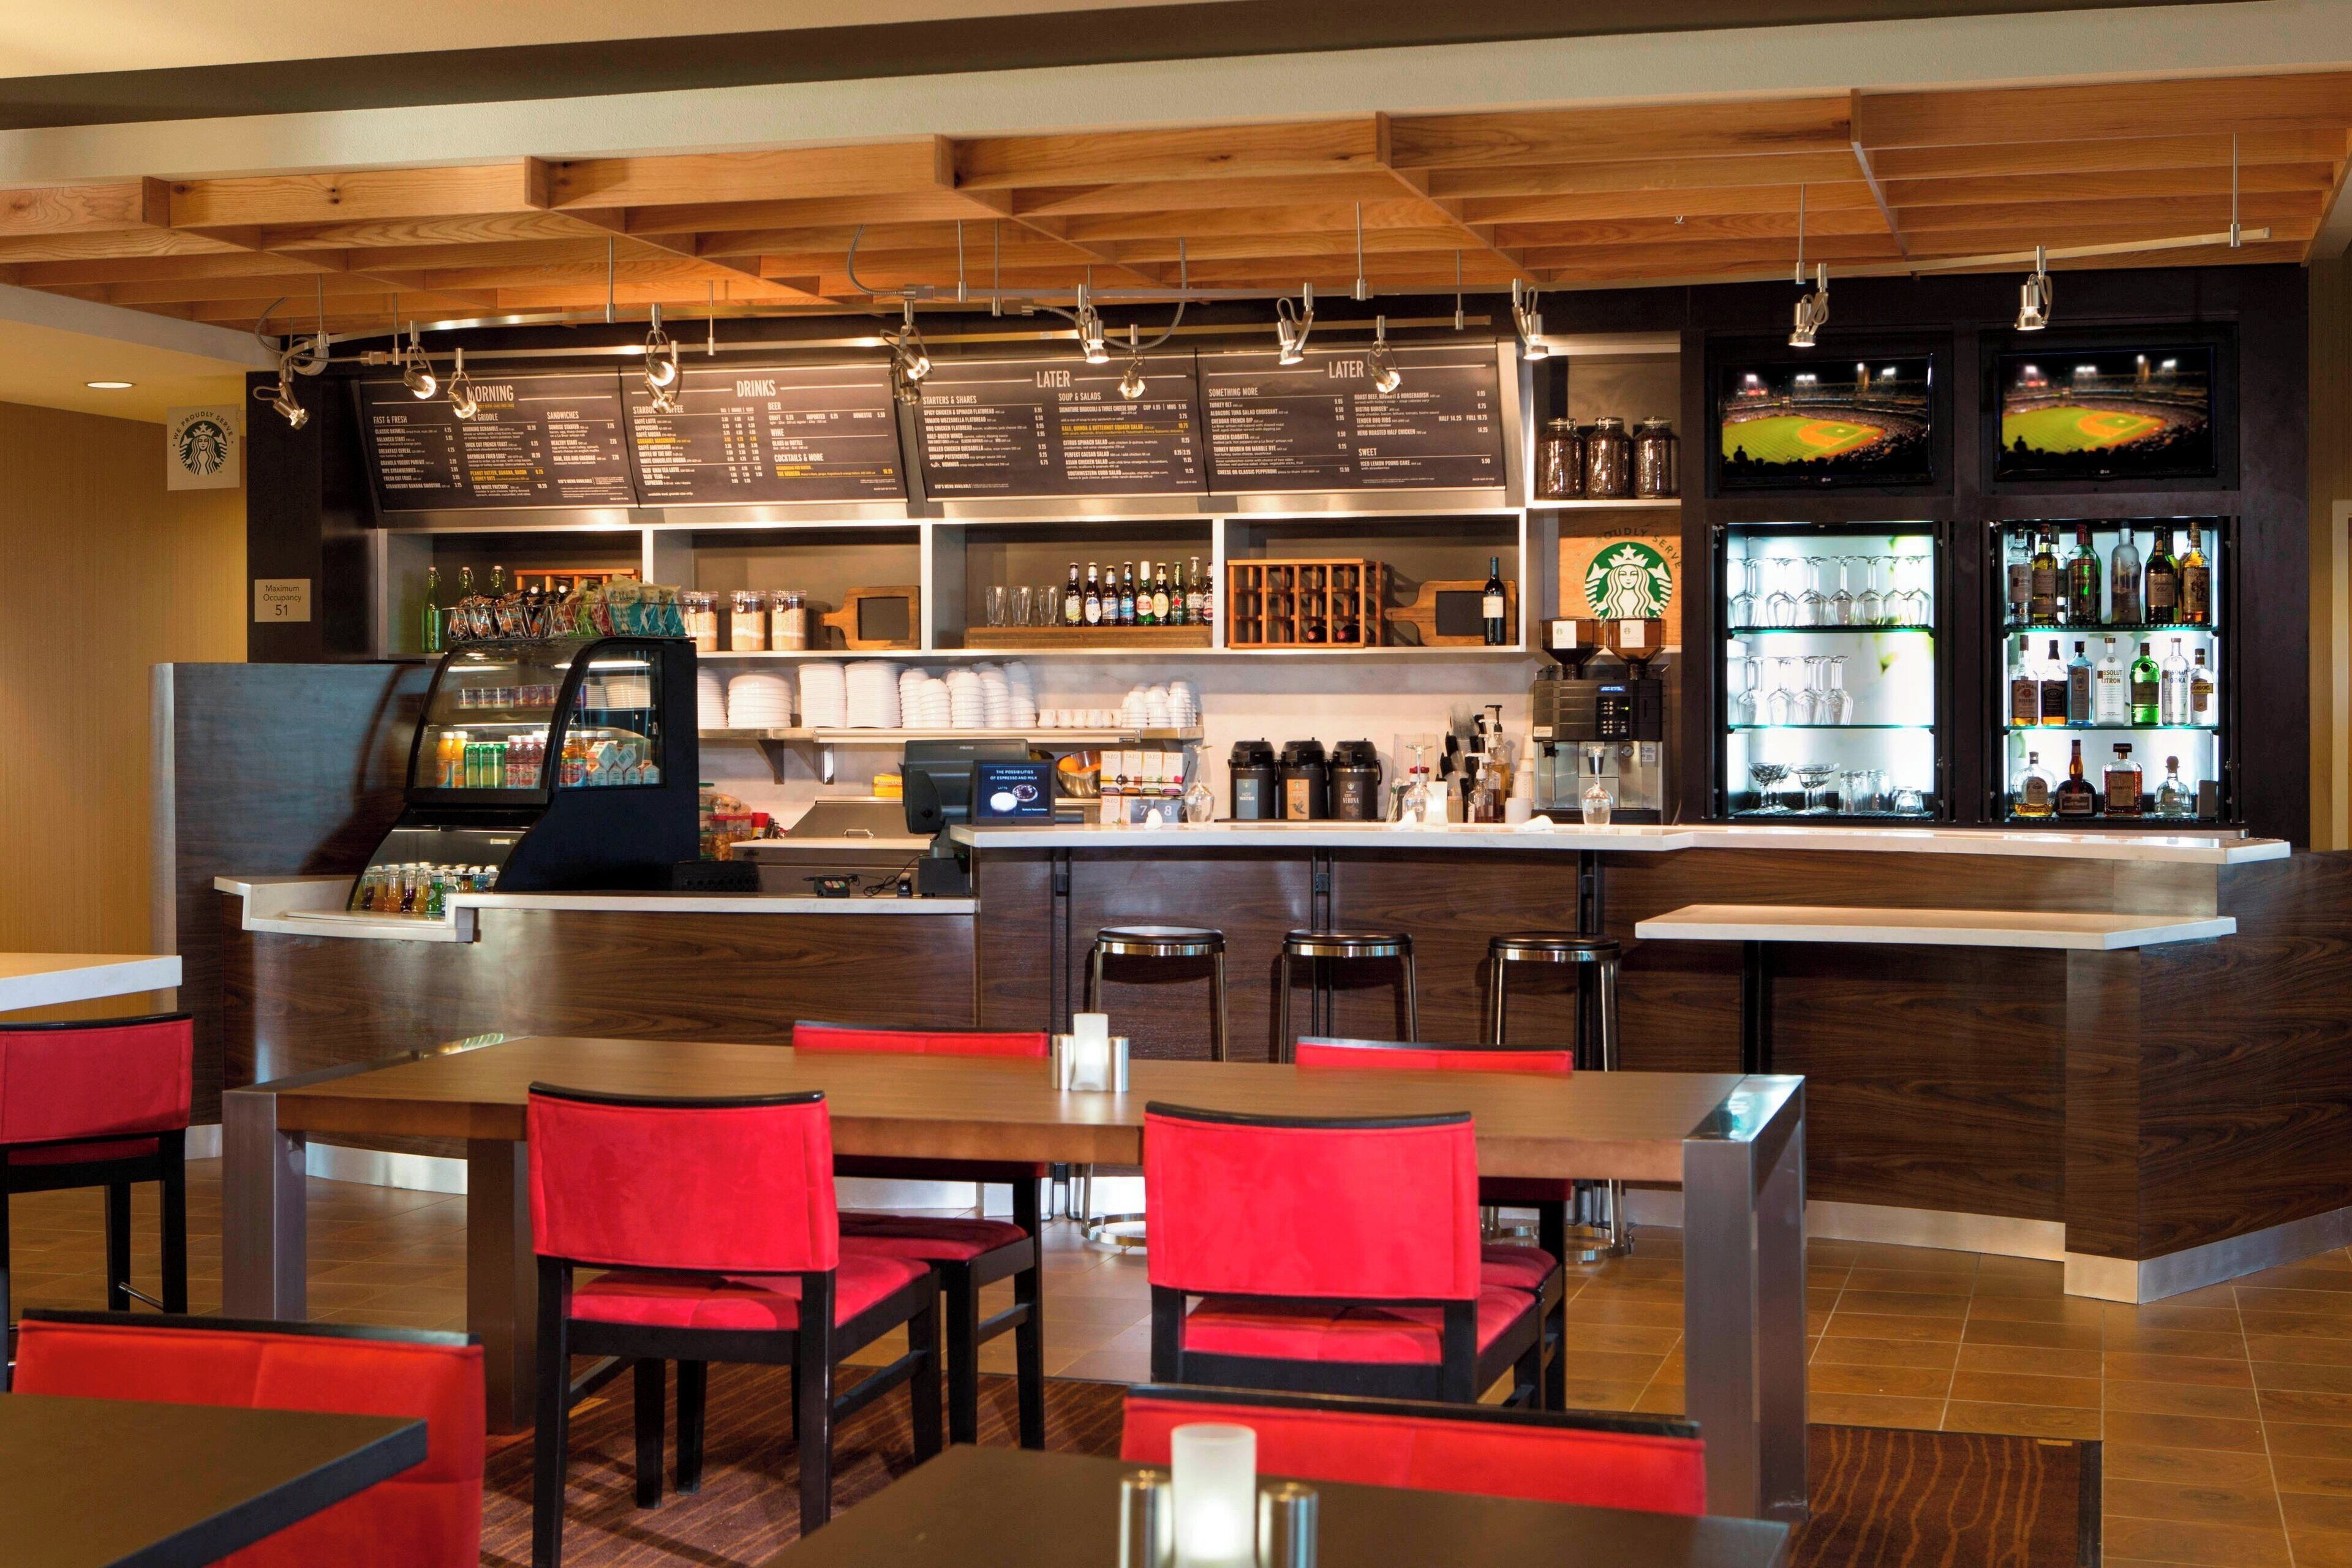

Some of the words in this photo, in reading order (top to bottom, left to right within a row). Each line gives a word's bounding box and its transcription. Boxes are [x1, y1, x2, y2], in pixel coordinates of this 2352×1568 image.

[1329, 360, 1364, 379] LATER
[1036, 371, 1070, 388] LATER
[466, 385, 513, 402] MORNING
[736, 379, 777, 398] DRINKS
[1208, 388, 1240, 397] SOMETHING
[1243, 387, 1258, 396] MORE
[923, 396, 949, 405] STARTERS
[1058, 393, 1072, 401] SOUP
[547, 411, 579, 420] SANDWICHES
[173, 428, 181, 440] WE
[181, 412, 214, 426] PROUDLY
[216, 416, 233, 436] SERVE
[1359, 448, 1377, 456] SWEET
[774, 454, 802, 462] COCKTAILS
[263, 594, 301, 602] Occupancy
[275, 605, 288, 616] 51
[1140, 805, 1147, 816] 7
[1164, 805, 1172, 816] 8
